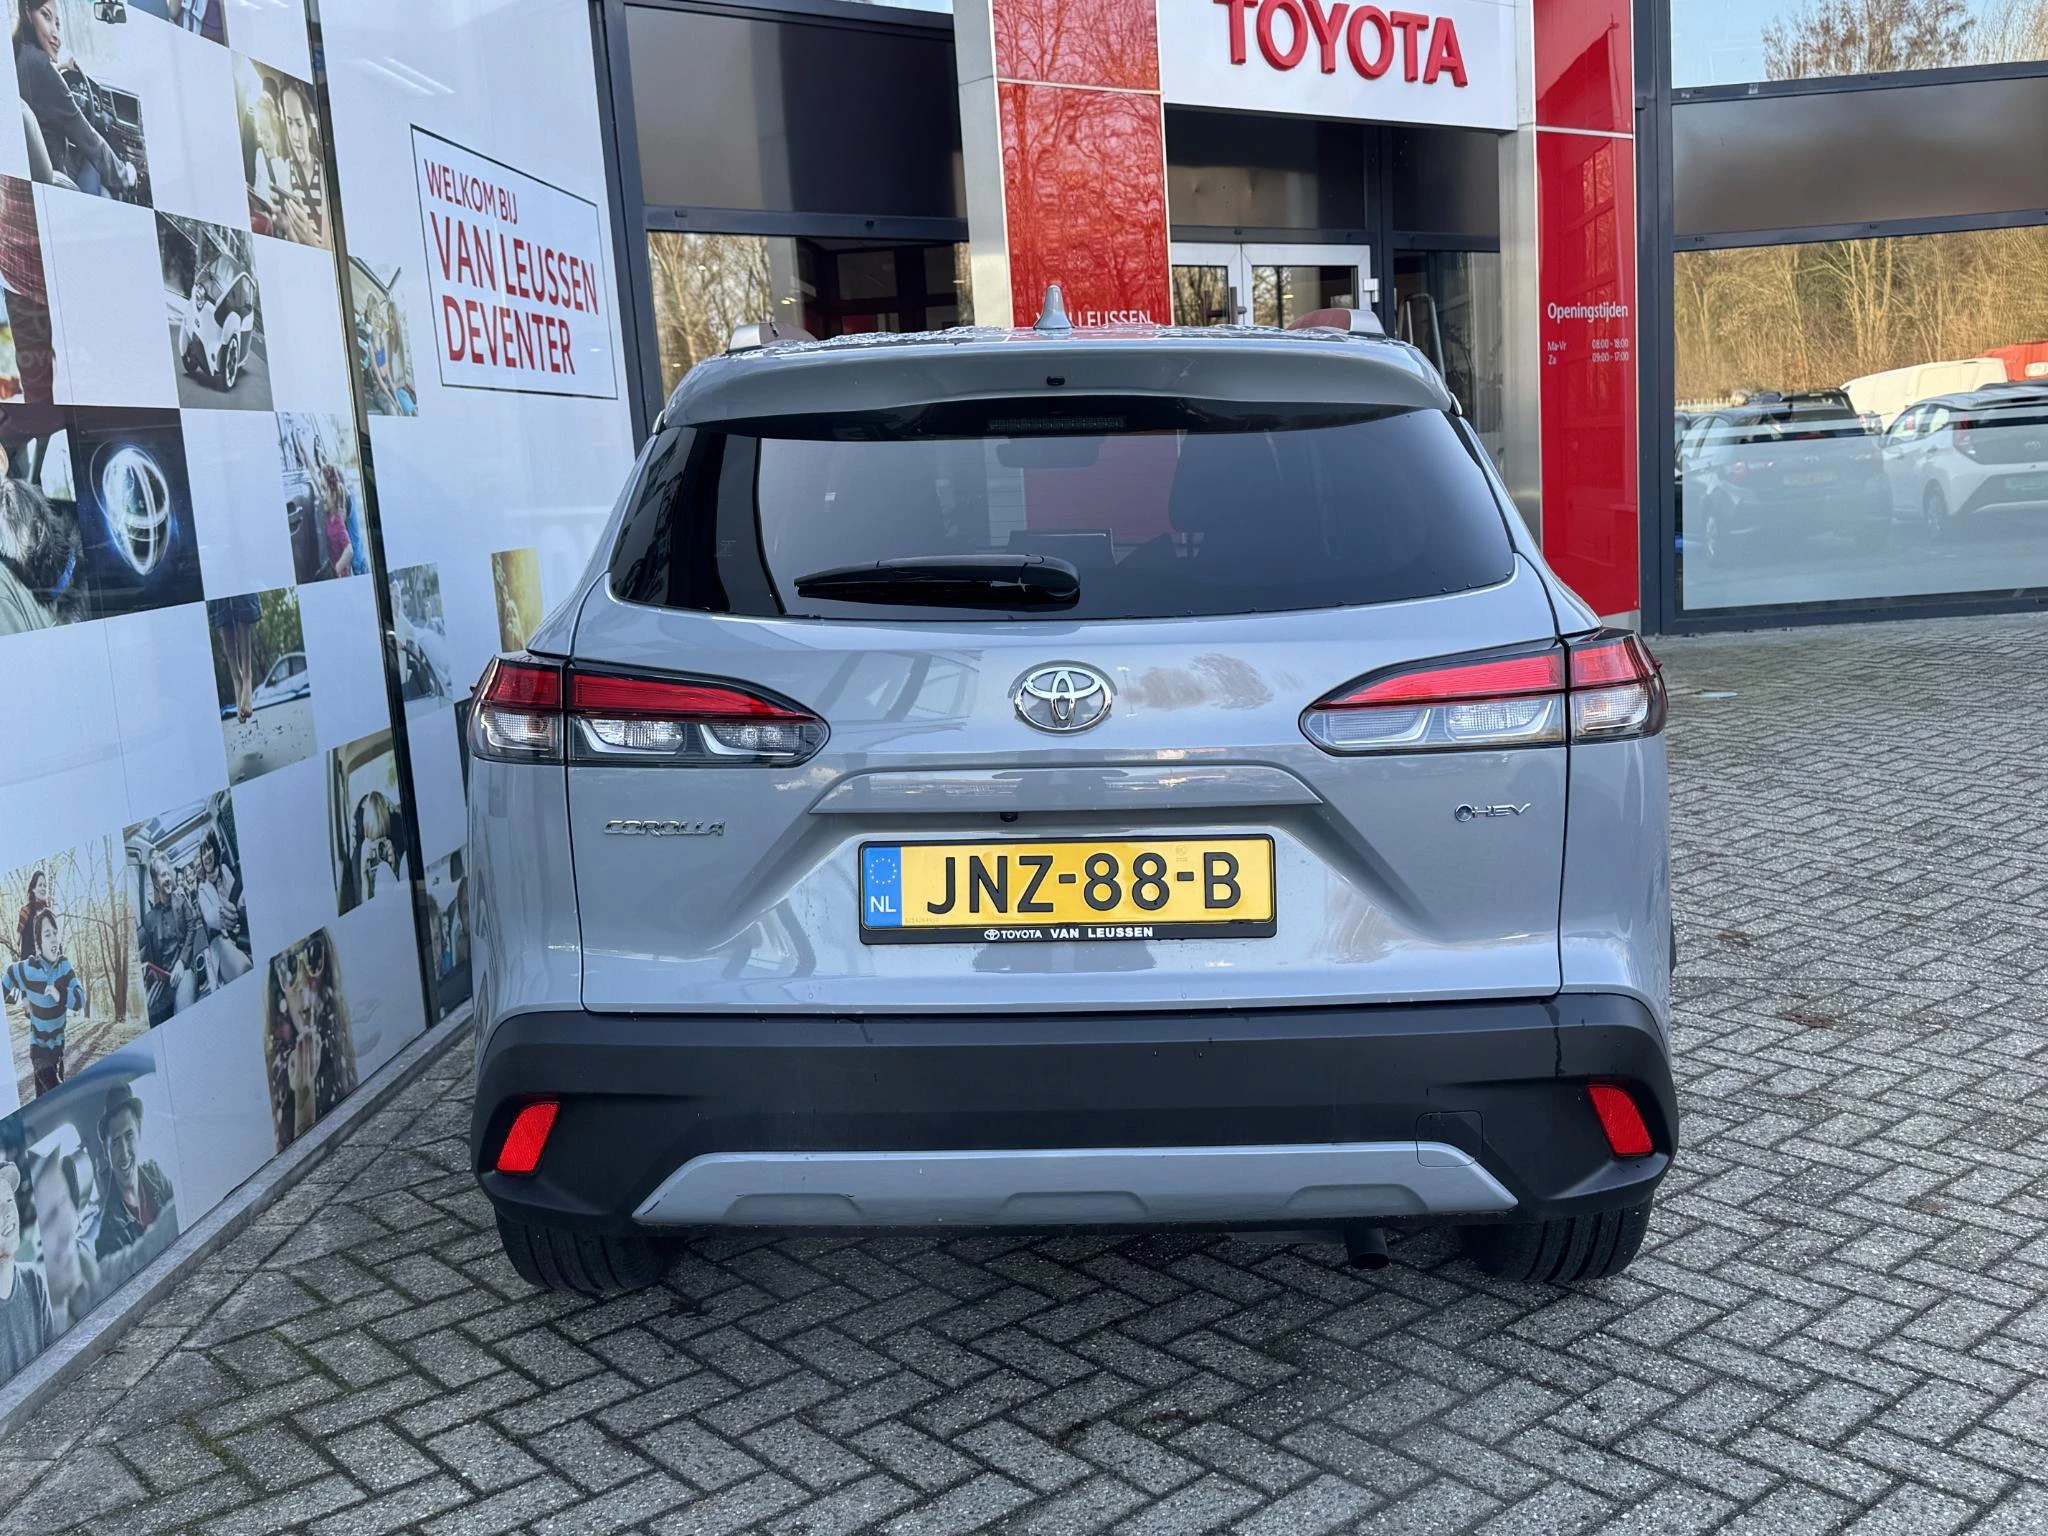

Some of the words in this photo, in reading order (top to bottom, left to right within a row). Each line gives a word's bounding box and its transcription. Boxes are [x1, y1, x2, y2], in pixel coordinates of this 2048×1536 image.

[1213, 0, 1468, 87] TOYOTA
[424, 159, 497, 218] WELKOM
[498, 187, 518, 225] BIJ
[430, 211, 496, 291] VAN
[499, 233, 599, 315] LEUSSEN
[442, 295, 575, 375] DEVENTER
[1547, 302, 1628, 324] Openingstijden
[603, 819, 726, 837] COROLLA
[870, 895, 897, 913] NL
[927, 851, 1241, 914] JNZ-88-B
[1001, 929, 1043, 940] TOYOTA
[1050, 928, 1079, 939] VAN
[1087, 927, 1154, 938] LEUSSEN
